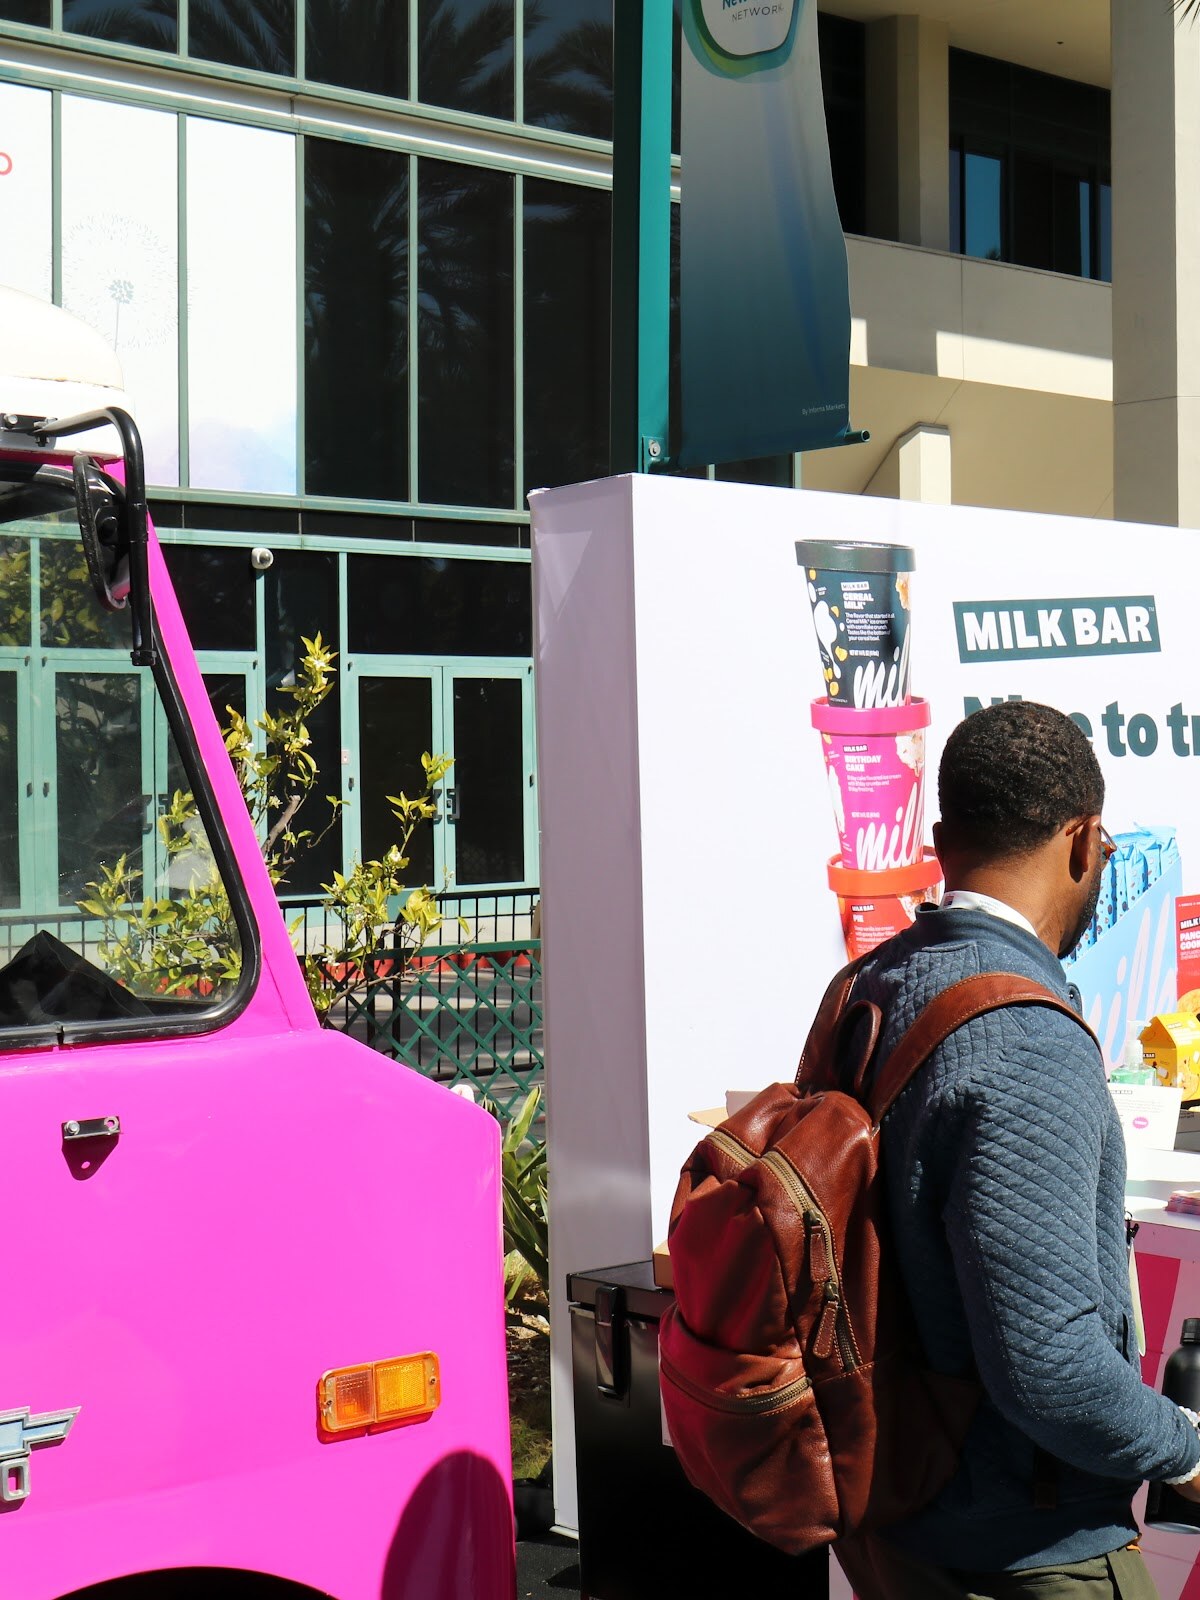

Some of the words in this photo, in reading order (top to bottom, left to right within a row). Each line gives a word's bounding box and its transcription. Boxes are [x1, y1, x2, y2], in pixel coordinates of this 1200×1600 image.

[732, 4, 784, 21] NETWORK
[843, 592, 874, 601] CEREAL
[962, 608, 1068, 651] MILK
[1102, 700, 1159, 758] to
[844, 755, 881, 764] BIRTHDAY
[846, 764, 865, 772] CAKE
[853, 914, 864, 922] PIE
[1180, 918, 1198, 930] MILK
